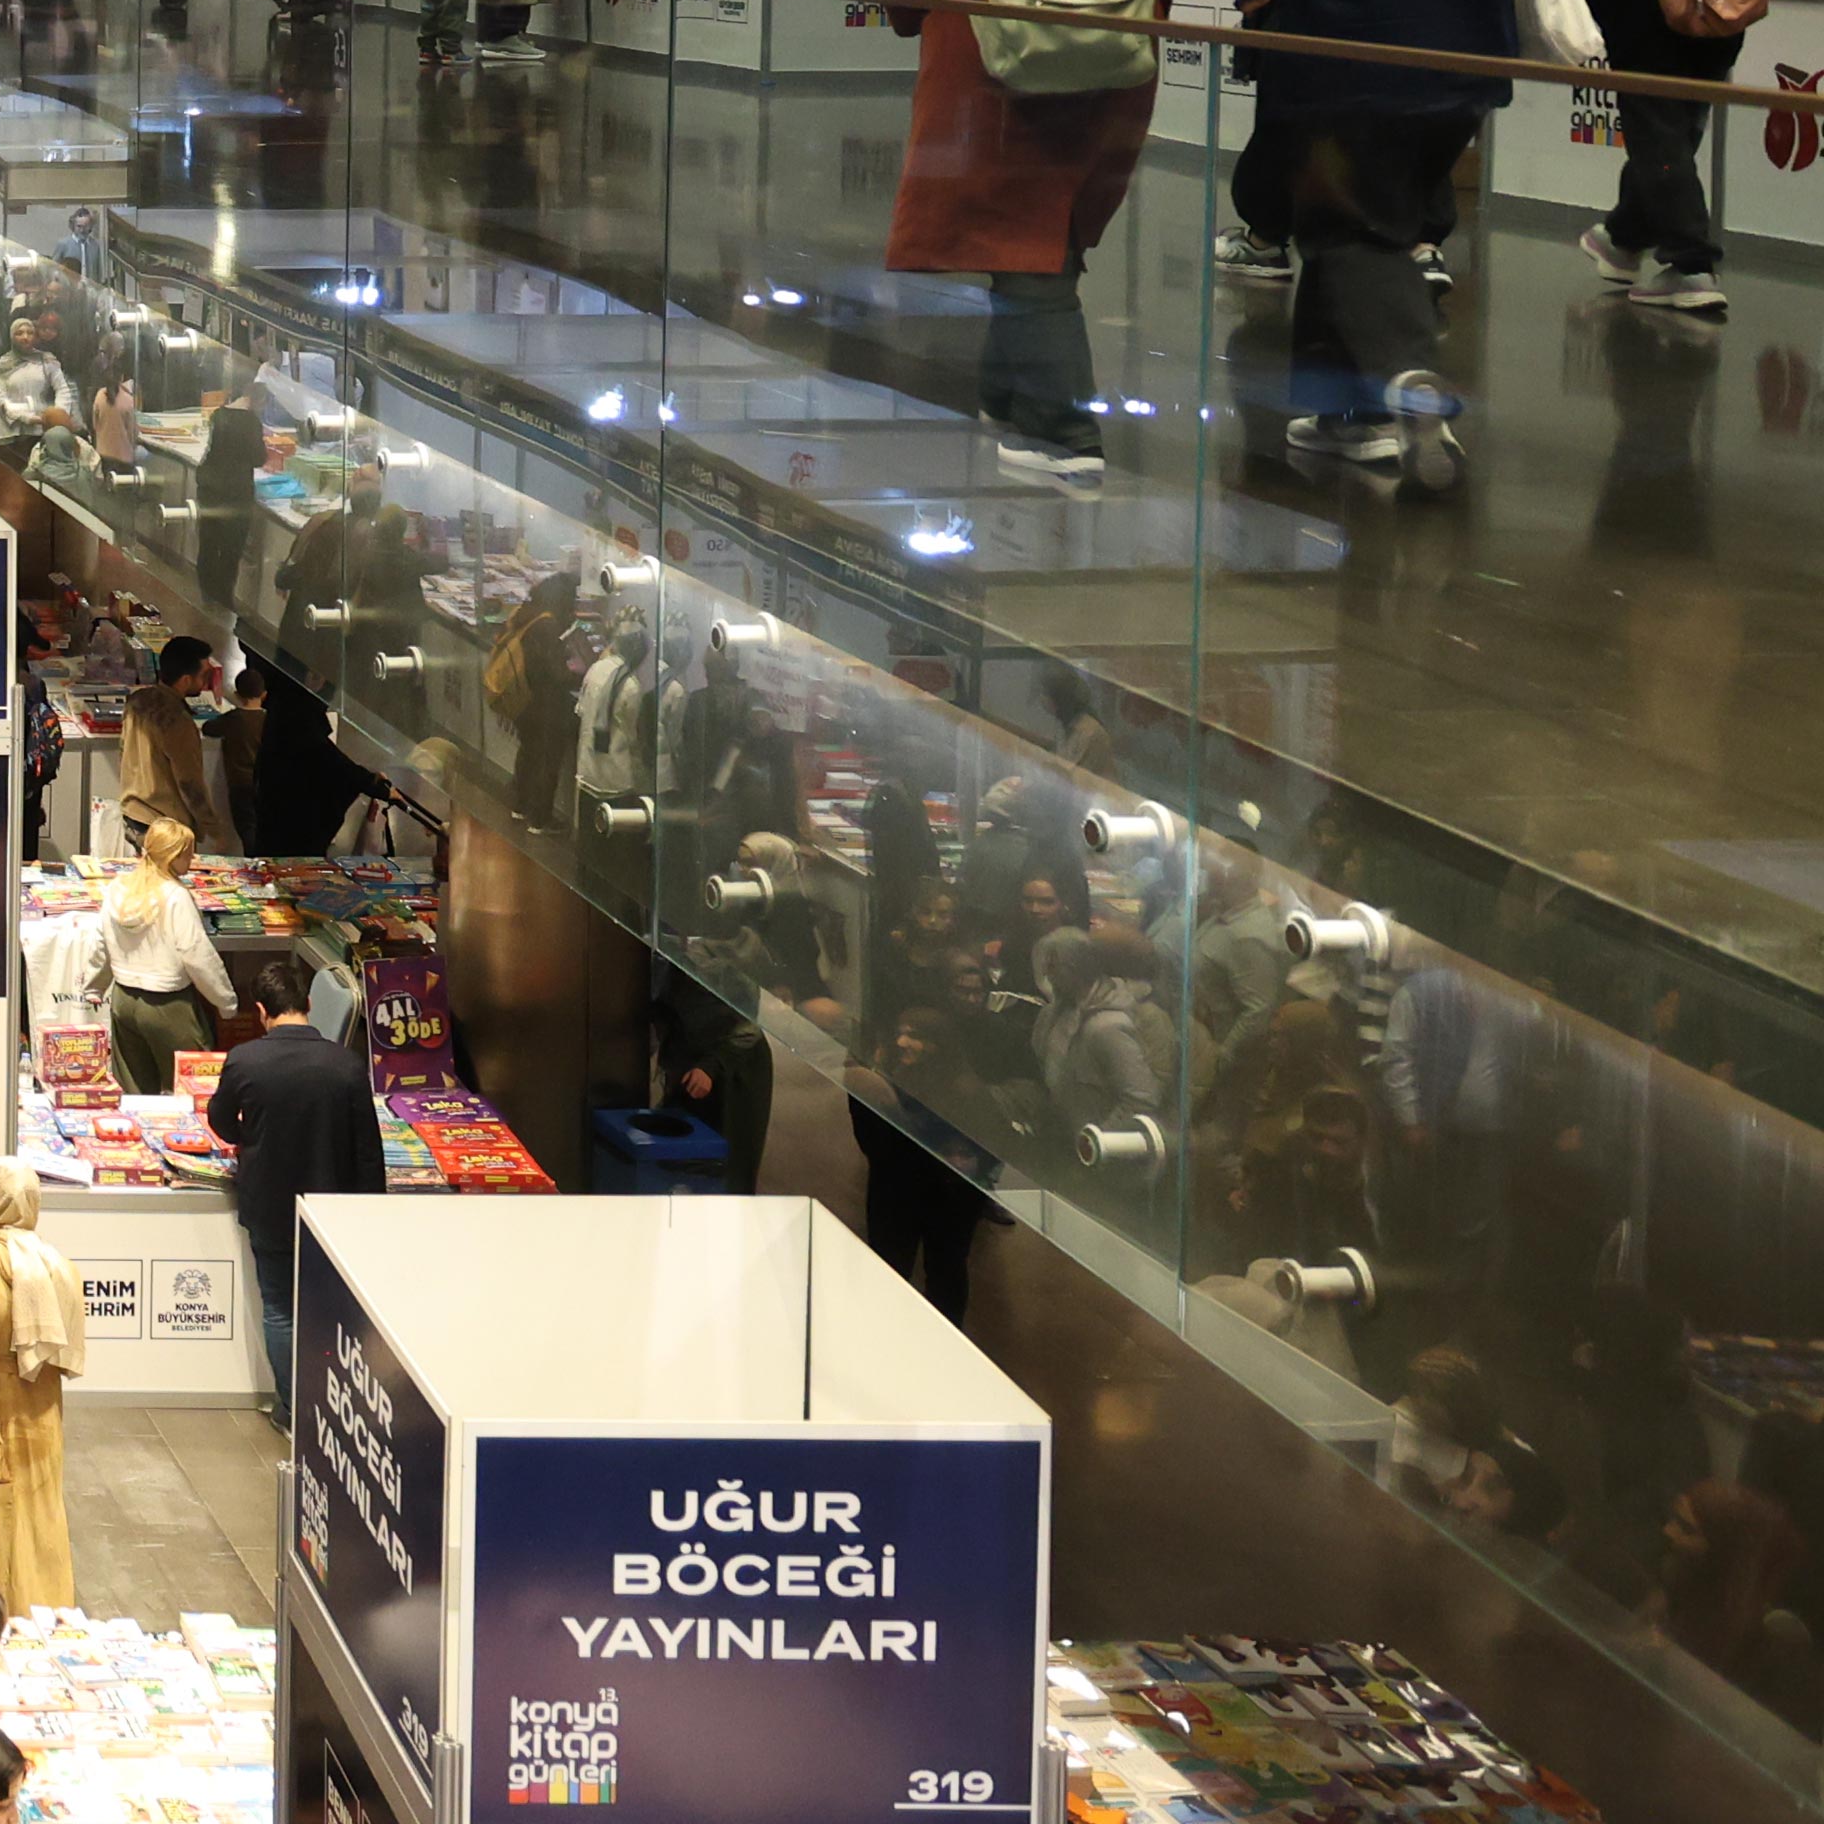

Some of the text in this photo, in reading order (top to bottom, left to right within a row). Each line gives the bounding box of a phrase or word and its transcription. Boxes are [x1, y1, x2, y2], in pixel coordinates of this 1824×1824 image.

[408, 1017, 442, 1039] ÖDE
[83, 1280, 135, 1297] ENİM
[175, 1303, 208, 1311] KONYA
[158, 1312, 225, 1325] BÜYÜKŞEHİR
[337, 1323, 394, 1440] UĞUR
[326, 1367, 402, 1517] BÖCEĞİ
[302, 1455, 328, 1520] konya
[315, 1404, 412, 1596] YAYINLARI
[650, 1479, 862, 1533] UĞUR
[302, 1482, 328, 1546] kitap
[613, 1542, 896, 1597] BÖCEĞİ
[561, 1616, 938, 1661] YAYINLARI
[510, 1696, 618, 1730] konya
[599, 1688, 619, 1702] 13.
[402, 1695, 429, 1758] 319
[510, 1725, 617, 1763] kitap
[509, 1760, 617, 1790] günleri
[908, 1770, 994, 1803] 319
